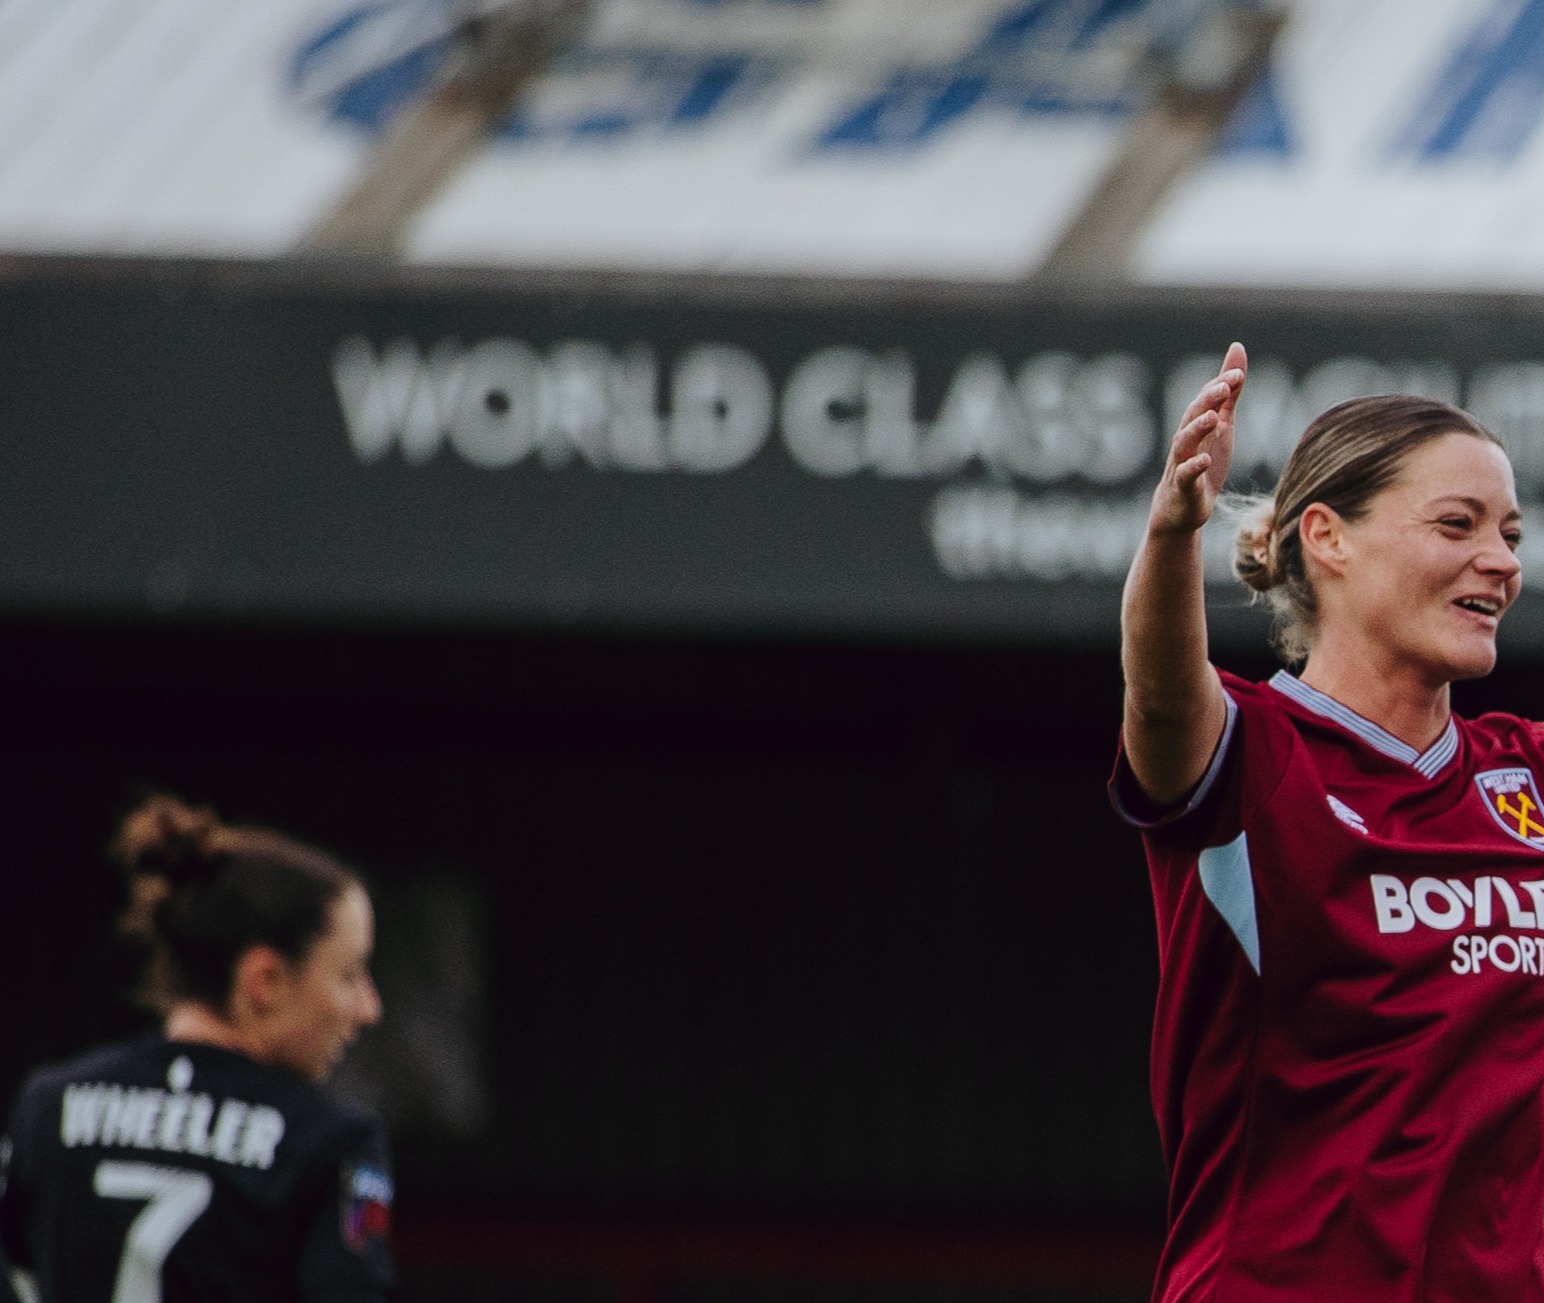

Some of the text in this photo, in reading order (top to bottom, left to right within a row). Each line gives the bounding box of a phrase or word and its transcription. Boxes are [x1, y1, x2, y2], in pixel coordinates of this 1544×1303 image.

[331, 335, 770, 474] WORLD
[782, 343, 1156, 484] CLASS
[61, 1083, 285, 1169] WHEELER
